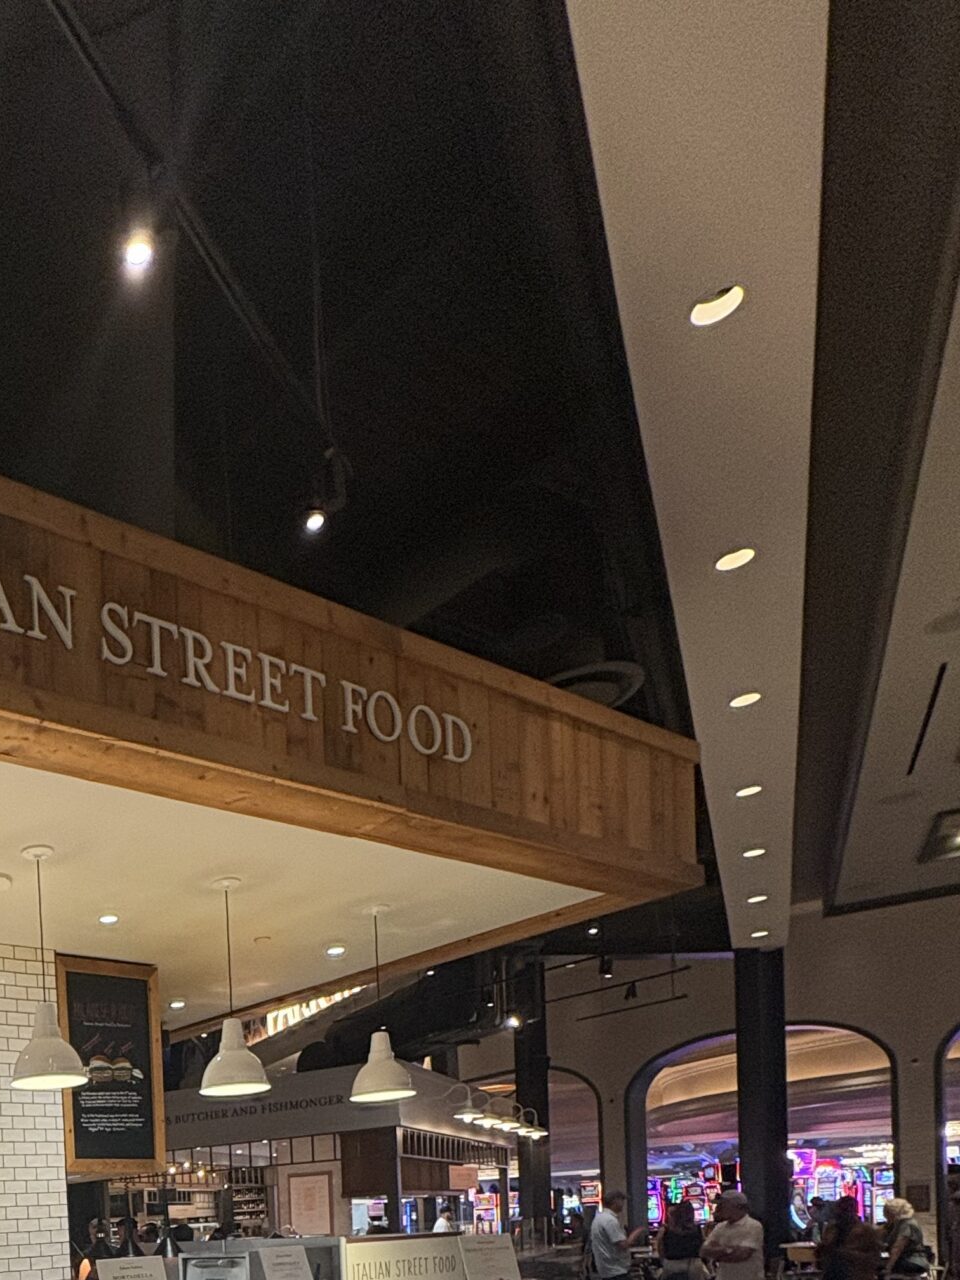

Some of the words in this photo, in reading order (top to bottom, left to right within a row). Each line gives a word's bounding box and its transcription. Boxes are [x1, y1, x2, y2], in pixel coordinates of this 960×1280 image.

[100, 601, 326, 723] STREET
[339, 678, 475, 765] FOOD
[174, 1109, 229, 1125] BUTCHER
[231, 1104, 258, 1117] AND
[261, 1094, 345, 1115] FISHMONGER
[395, 1255, 429, 1279] STREET
[432, 1254, 457, 1273] FOOD
